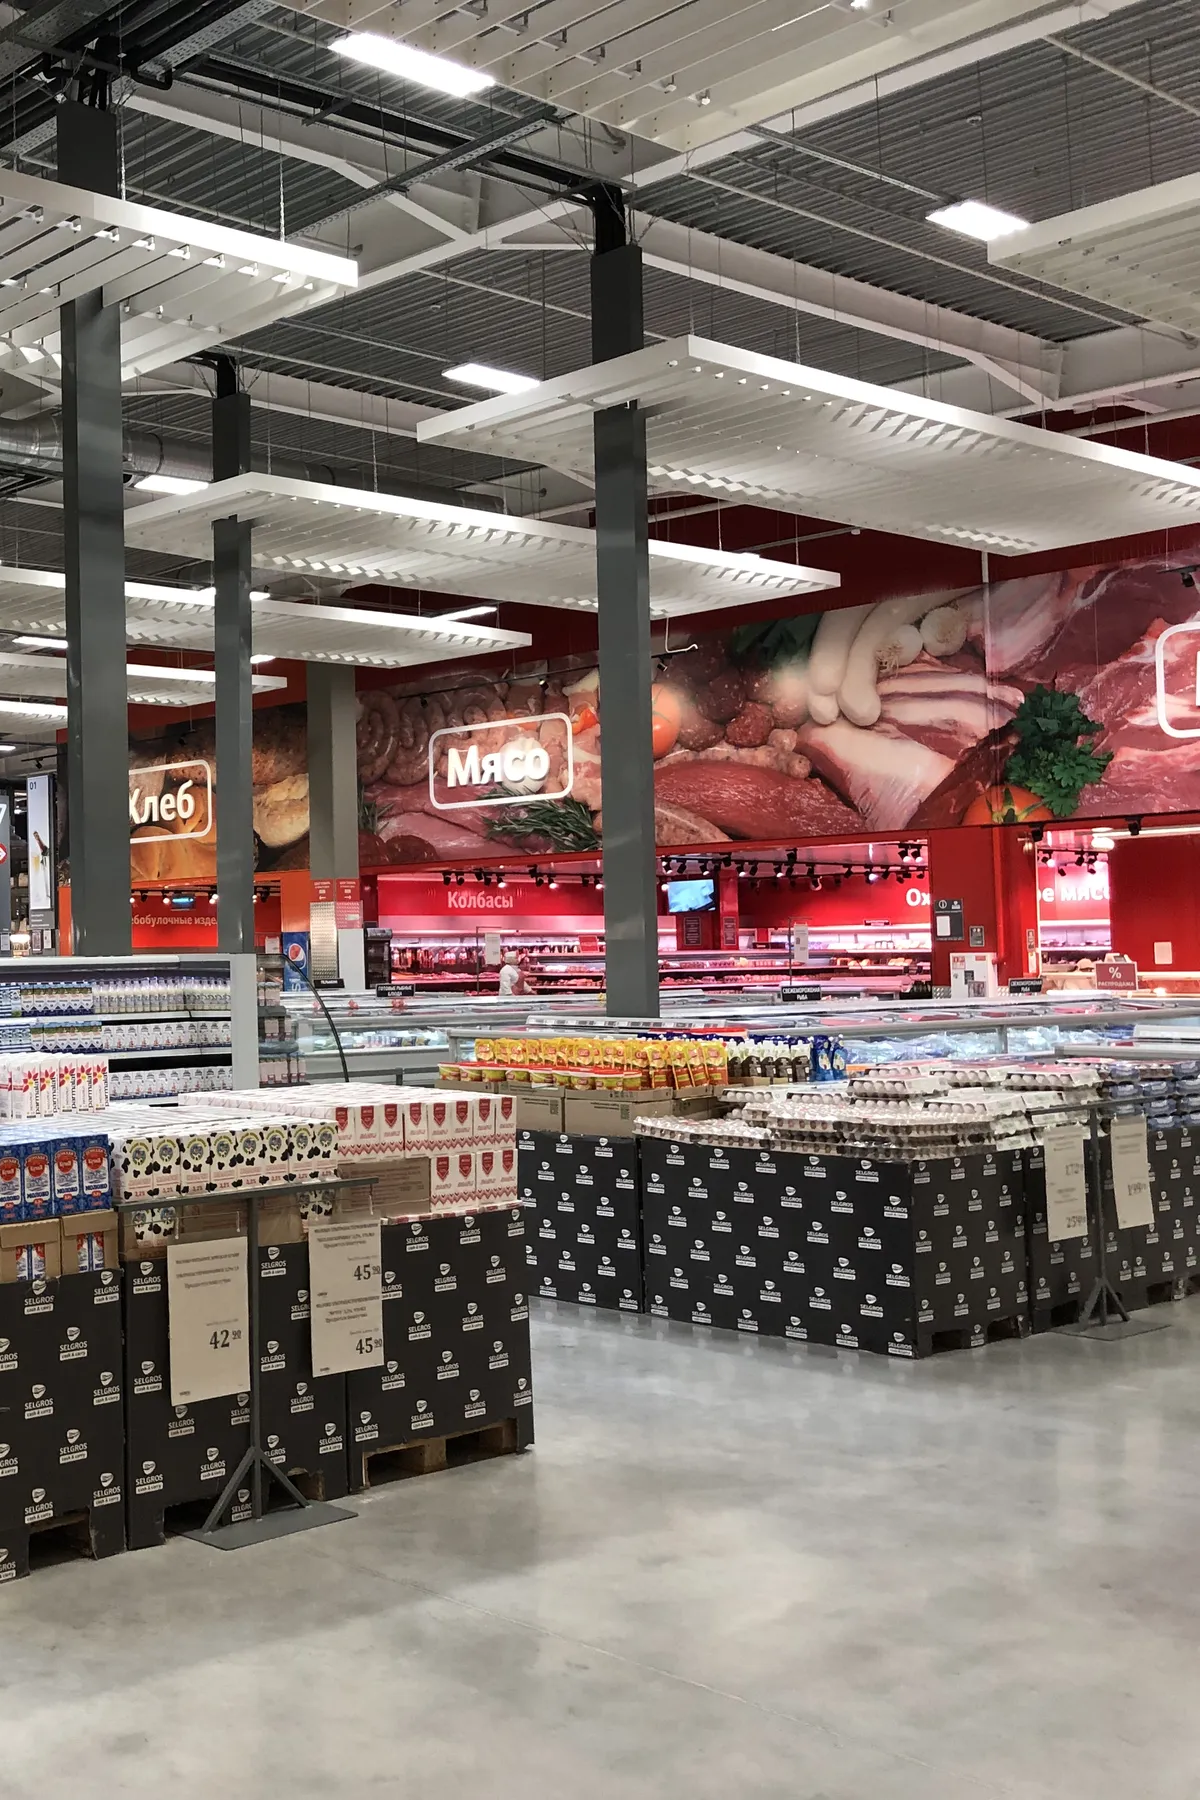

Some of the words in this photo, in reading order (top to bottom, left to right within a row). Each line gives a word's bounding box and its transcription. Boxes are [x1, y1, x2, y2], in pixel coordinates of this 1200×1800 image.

[447, 744, 550, 788] Мясо
[29, 781, 37, 790] 01
[447, 890, 514, 909] Колбасы
[194, 917, 218, 926] изде
[406, 1236, 428, 1244] SELGROS
[262, 1260, 286, 1268] SELGROS
[353, 1264, 372, 1281] 45
[486, 1268, 505, 1276] SELGROS
[133, 1276, 160, 1285] SELGROS
[434, 1276, 456, 1284] SELGROS
[94, 1285, 119, 1295] SELGROS
[25, 1296, 54, 1305] SELGROS
[462, 1315, 483, 1323] SELGROS
[408, 1324, 431, 1333] SELGROS
[209, 1329, 230, 1350] 42
[60, 1341, 87, 1352] SELGROS
[355, 1337, 373, 1355] 45
[261, 1354, 285, 1363] SELGROS
[489, 1353, 508, 1362] SELGROS
[437, 1363, 459, 1372] SELGROS
[134, 1375, 162, 1385] SELGROS
[382, 1373, 405, 1382] SELGROS
[94, 1386, 120, 1396] SELGROS
[25, 1398, 53, 1410] SELGROS
[291, 1395, 314, 1405] SELGROS
[465, 1401, 486, 1410] SELGROS
[411, 1412, 433, 1422] SELGROS
[168, 1418, 194, 1429] SELGROS
[355, 1424, 378, 1434] SELGROS
[320, 1436, 342, 1445] SELGROS
[60, 1443, 87, 1455] SELGROS
[201, 1460, 225, 1472] SELGROS
[136, 1474, 163, 1485] SELGROS
[94, 1486, 120, 1498] SELGROS
[25, 1502, 53, 1514] SELGROS
